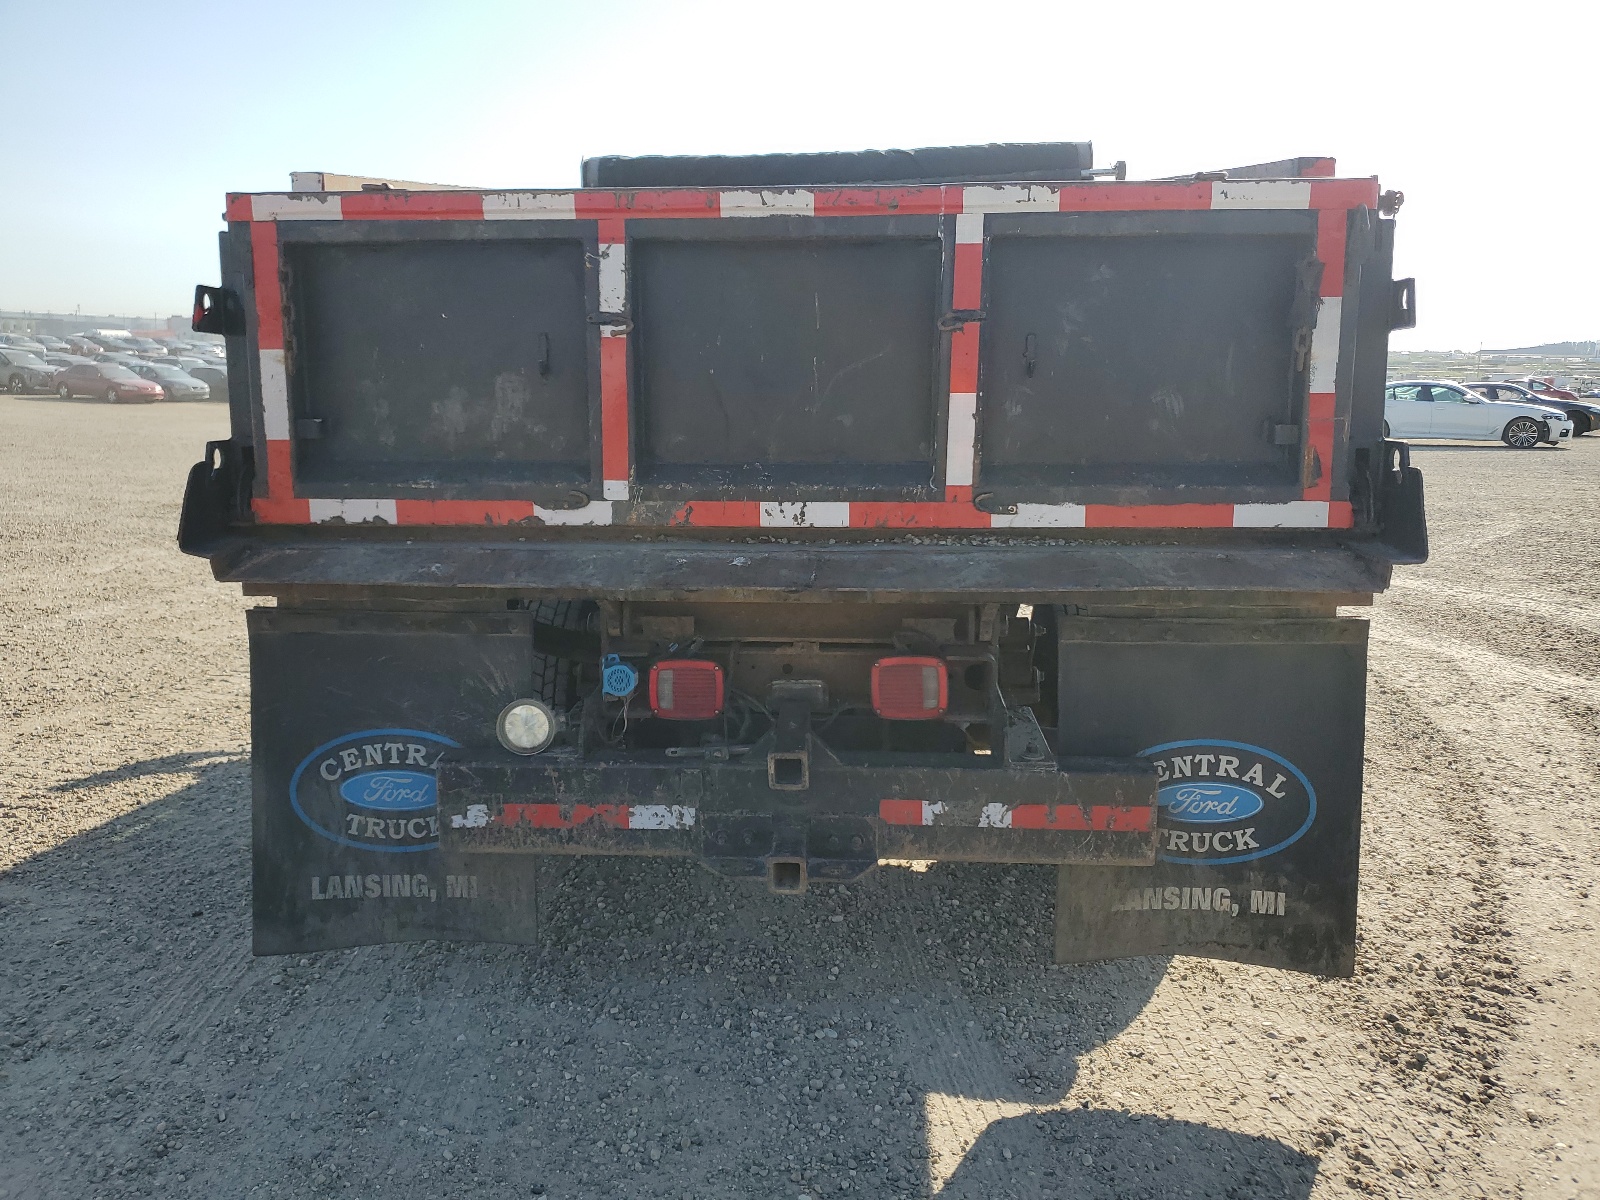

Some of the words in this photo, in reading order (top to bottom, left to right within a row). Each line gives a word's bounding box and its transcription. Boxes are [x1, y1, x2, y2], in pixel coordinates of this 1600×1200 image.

[320, 742, 446, 781] CENTR
[1153, 754, 1287, 799] ENTRAL
[363, 776, 429, 802] Ford
[1168, 788, 1240, 815] Ford
[311, 873, 437, 902] LANSING,
[446, 875, 478, 898] MI
[1111, 886, 1239, 917] ANSING,
[1250, 890, 1286, 915] MI
